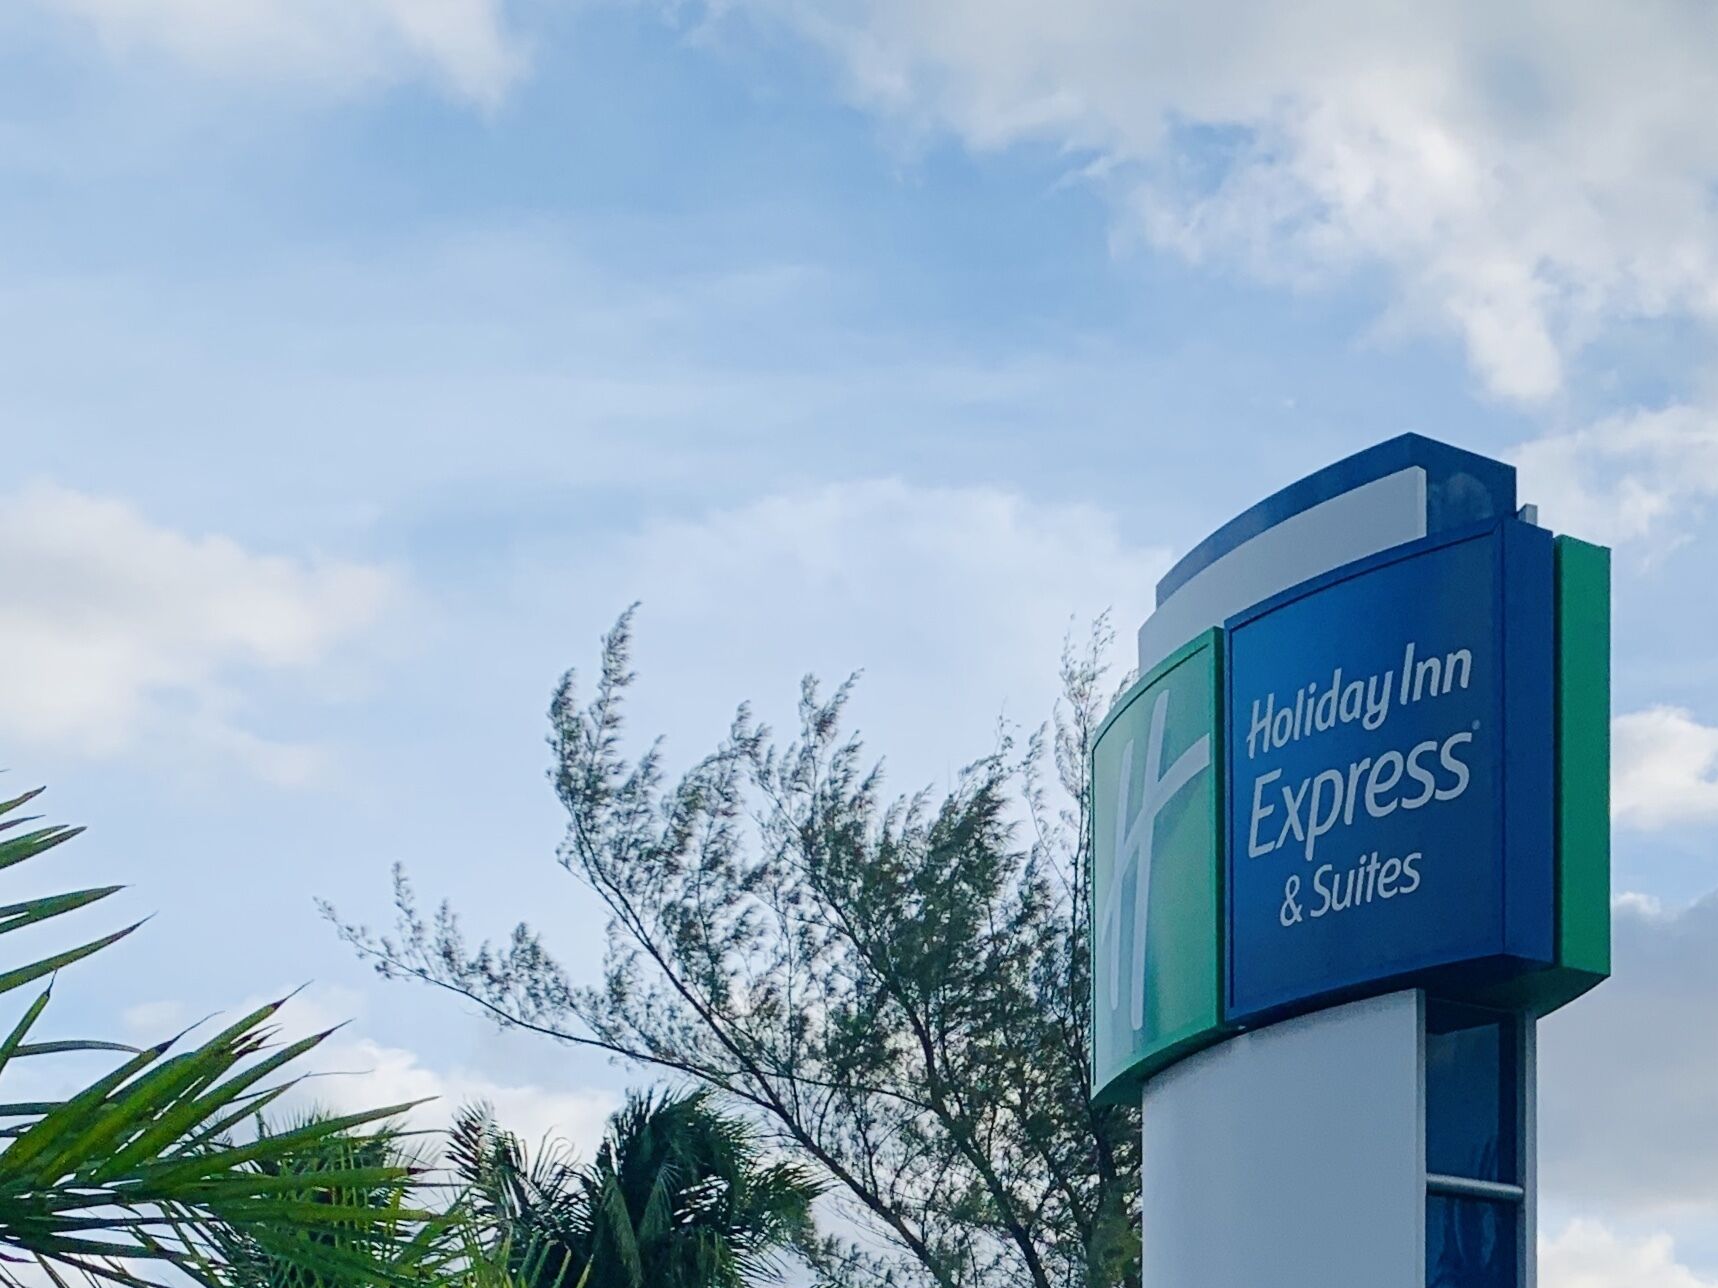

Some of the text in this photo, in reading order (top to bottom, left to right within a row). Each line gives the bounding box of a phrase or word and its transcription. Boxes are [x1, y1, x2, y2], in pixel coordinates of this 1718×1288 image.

[1246, 642, 1473, 760] Holiday Inn
[1248, 731, 1473, 862] Express
[1279, 851, 1423, 927] & Suites
